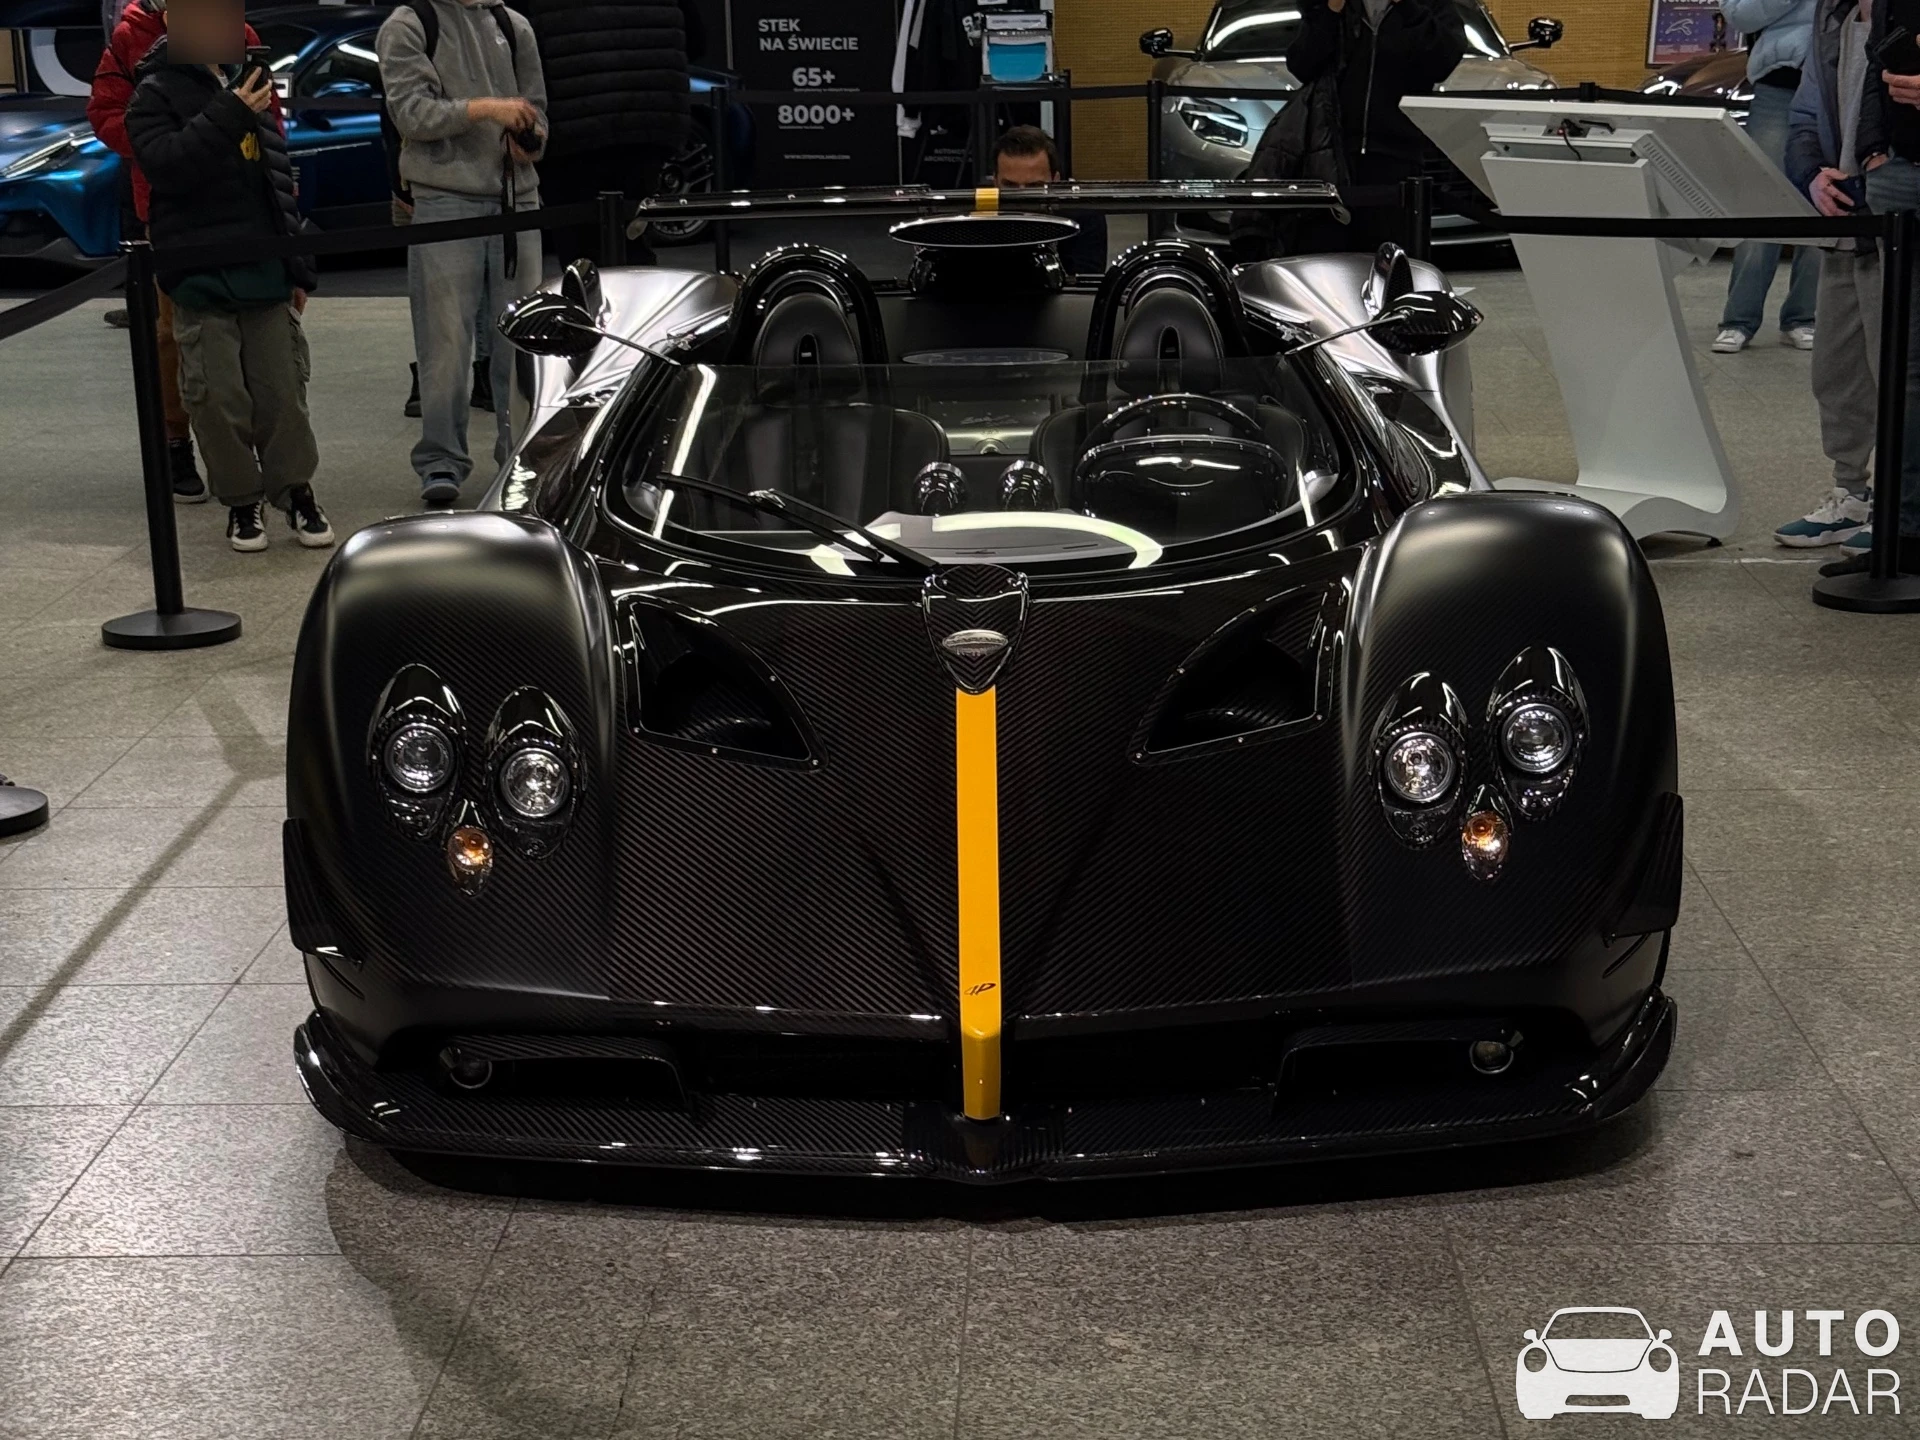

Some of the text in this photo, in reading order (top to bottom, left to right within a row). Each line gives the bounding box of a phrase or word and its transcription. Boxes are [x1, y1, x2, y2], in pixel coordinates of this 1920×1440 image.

[758, 19, 800, 32] STEK
[759, 34, 859, 51] NA ŚWIECIE
[792, 67, 836, 87] 65+
[778, 105, 855, 124] 8000+
